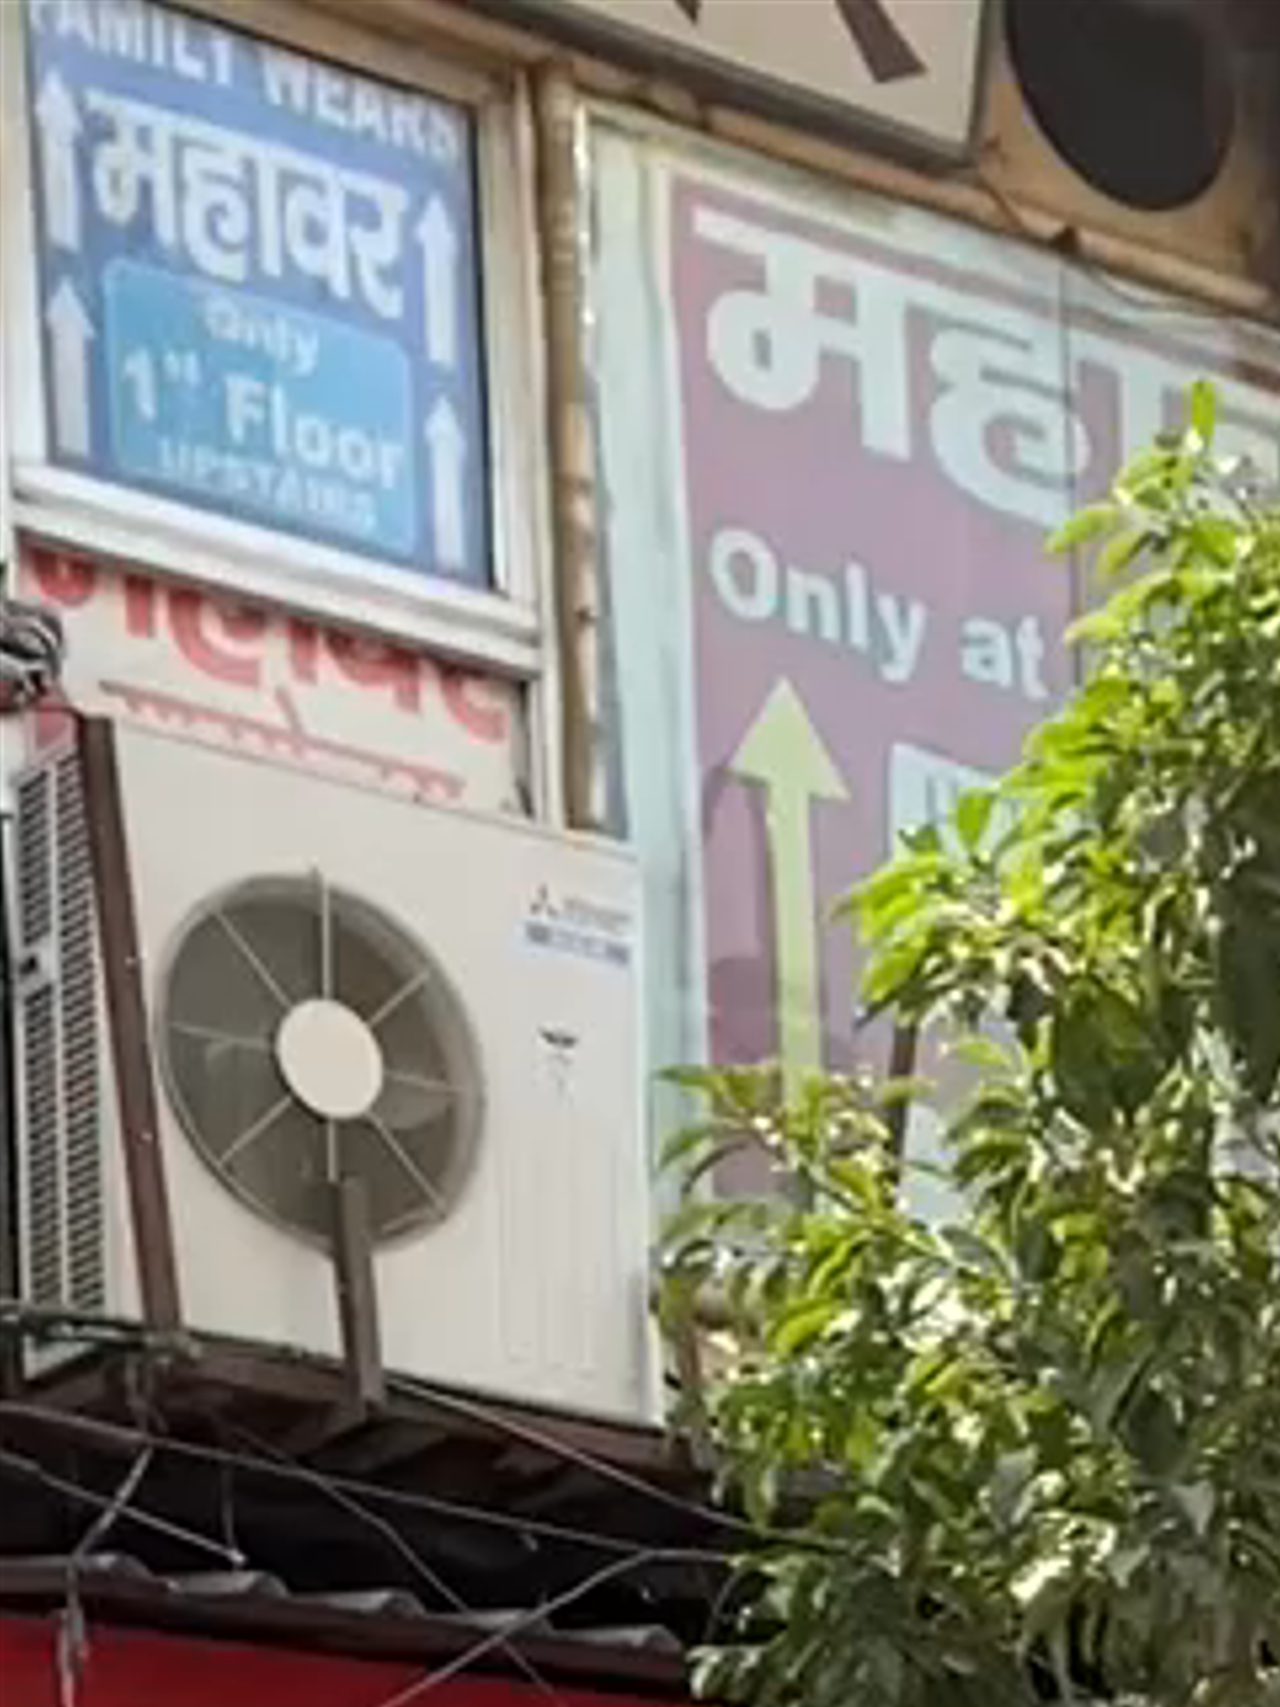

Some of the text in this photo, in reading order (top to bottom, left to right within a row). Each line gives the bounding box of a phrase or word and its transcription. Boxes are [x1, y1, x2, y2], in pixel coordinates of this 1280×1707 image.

[258, 40, 460, 162] WEARS
[84, 88, 408, 319] महावर
[201, 298, 320, 376] Only
[224, 373, 403, 490] Floor
[705, 528, 1046, 700] Only at
